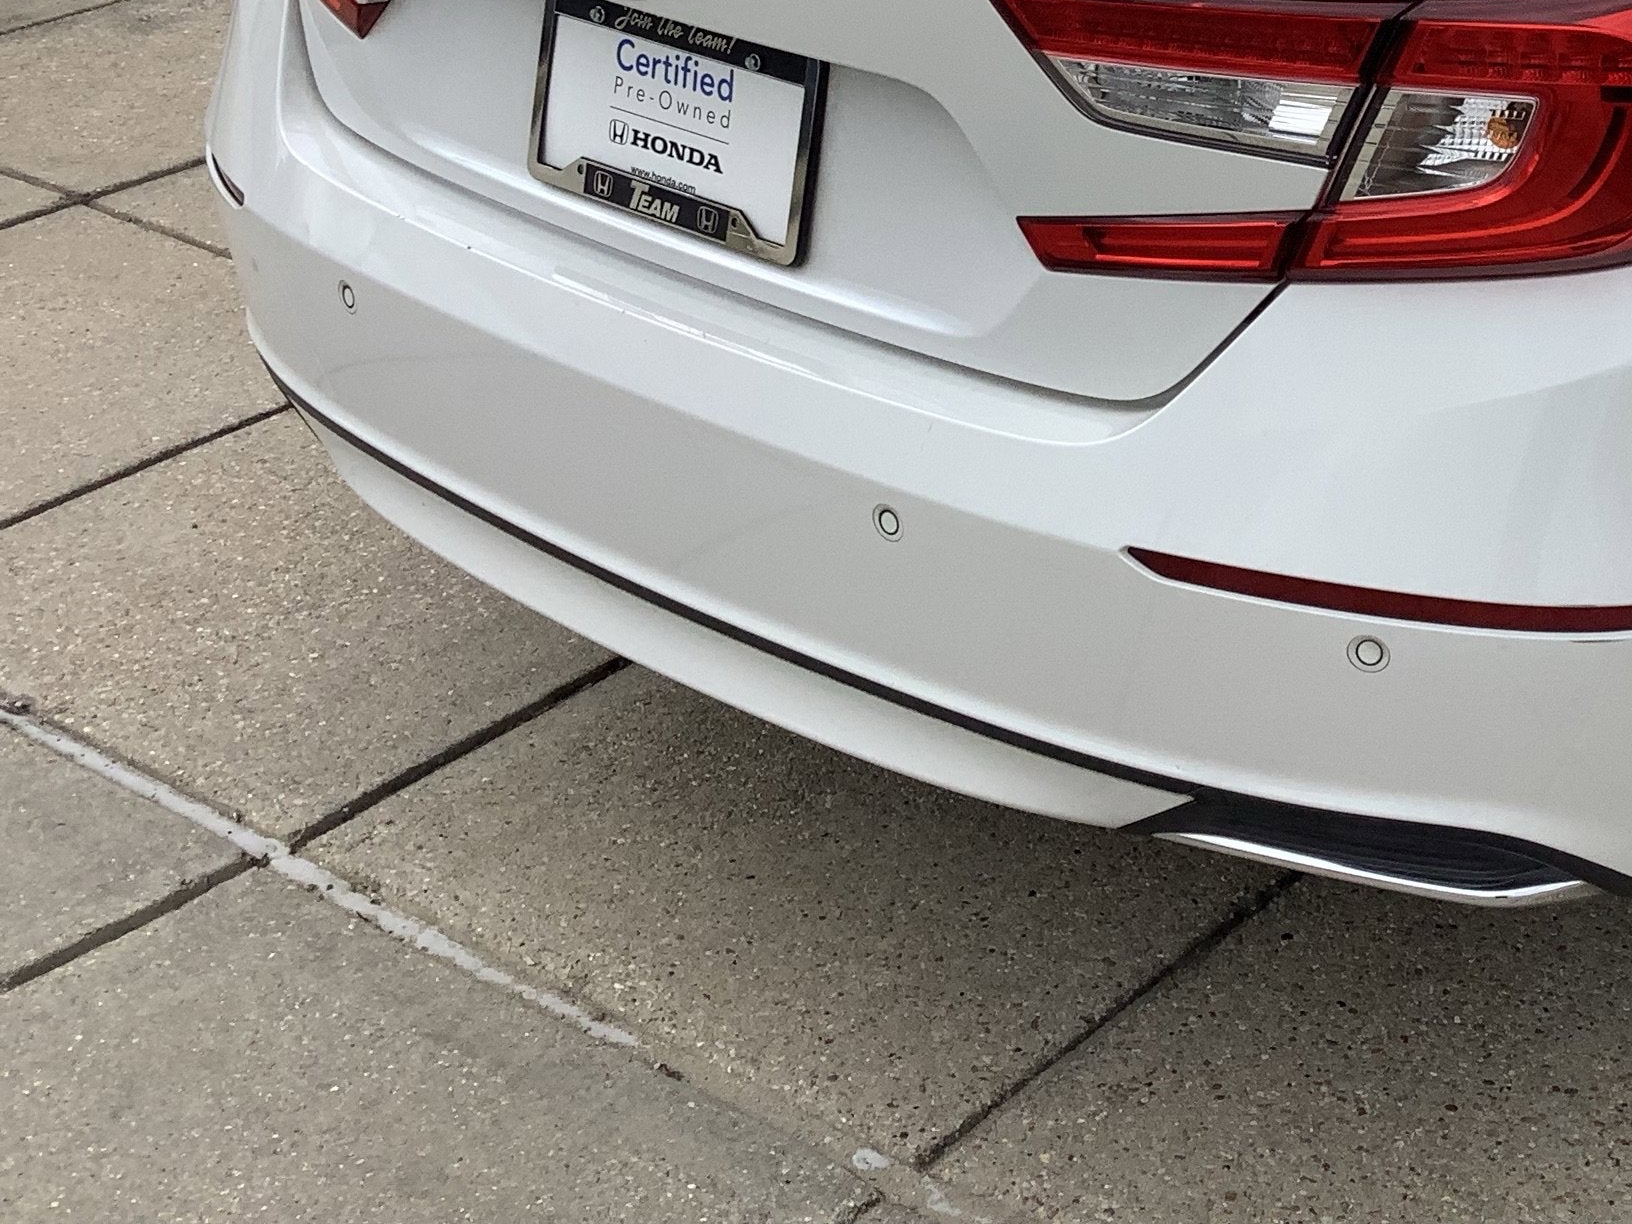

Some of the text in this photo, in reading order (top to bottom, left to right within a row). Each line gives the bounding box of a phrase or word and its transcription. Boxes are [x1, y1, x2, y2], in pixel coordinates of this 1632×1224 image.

[615, 7, 653, 30] Join
[656, 16, 684, 39] the
[616, 38, 735, 103] Certified
[613, 75, 732, 129] Pre-Owned
[630, 128, 724, 174] HONDA
[628, 179, 681, 223] TEAM
[630, 165, 697, 195] www.honda.com
